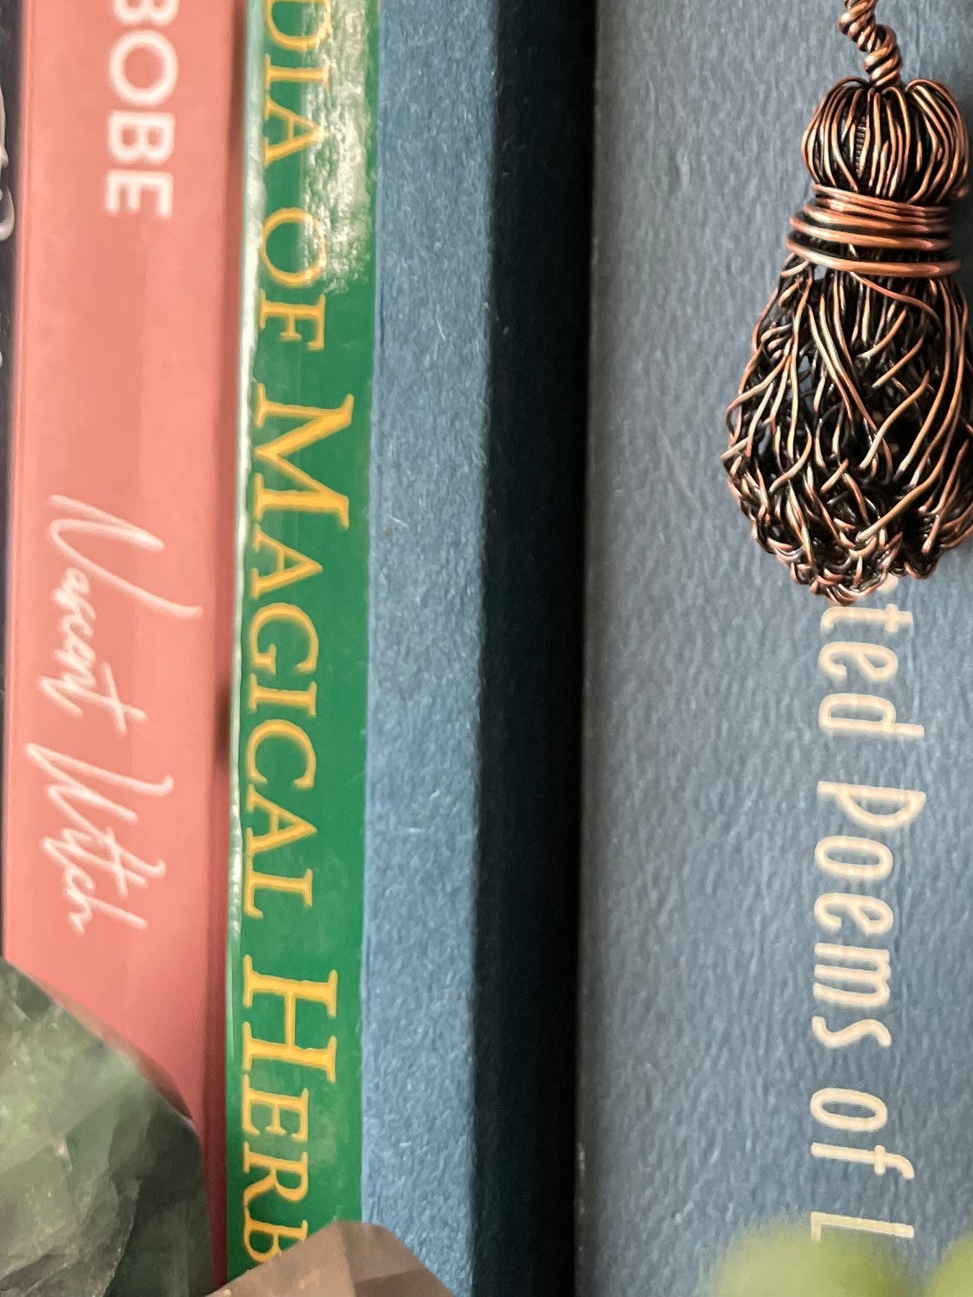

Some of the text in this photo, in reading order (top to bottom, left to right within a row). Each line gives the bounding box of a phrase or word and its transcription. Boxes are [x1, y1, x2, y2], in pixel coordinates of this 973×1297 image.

[258, 207, 327, 350] OF
[242, 383, 355, 920] MAGICAL
[810, 1087, 915, 1180] of
